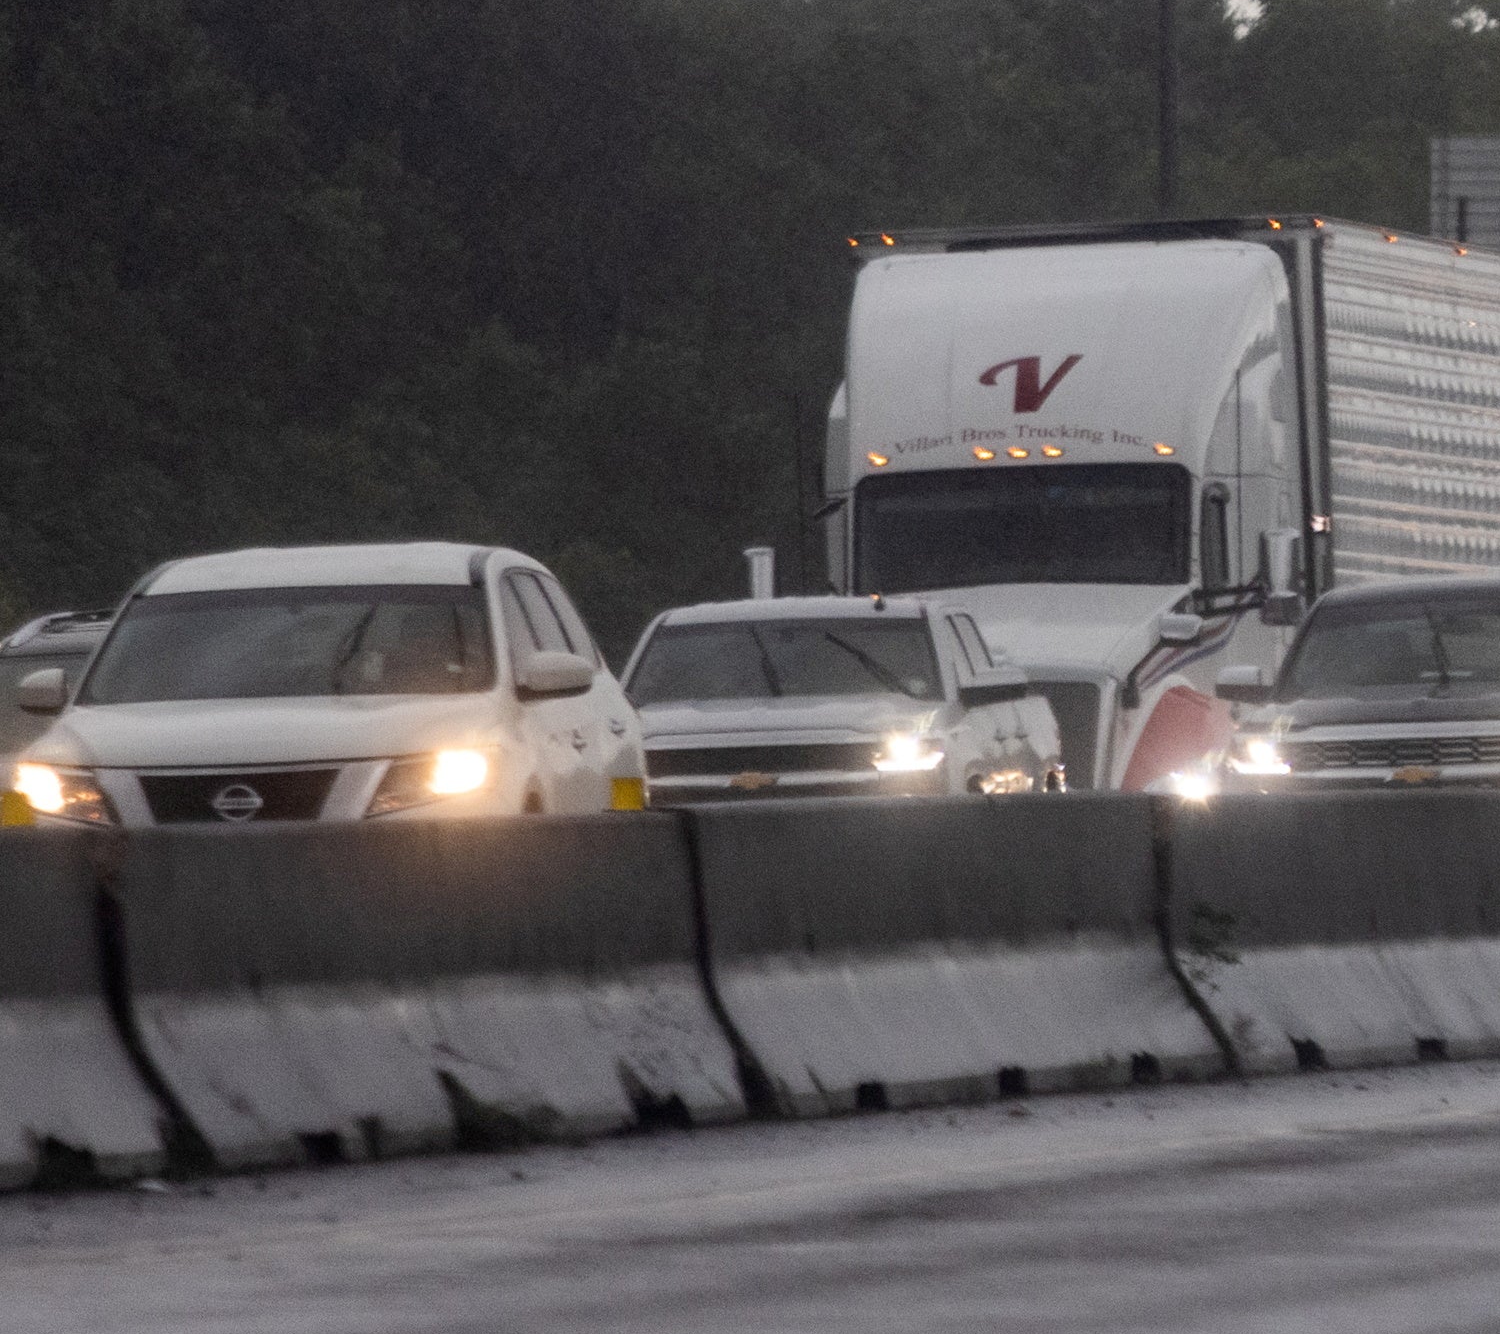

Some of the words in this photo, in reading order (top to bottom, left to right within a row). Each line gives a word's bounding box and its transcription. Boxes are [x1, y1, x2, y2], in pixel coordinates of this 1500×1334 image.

[978, 353, 1084, 414] V
[961, 427, 1007, 443] Bros
[1014, 423, 1104, 444] Trucking
[1111, 430, 1149, 447] Inc.
